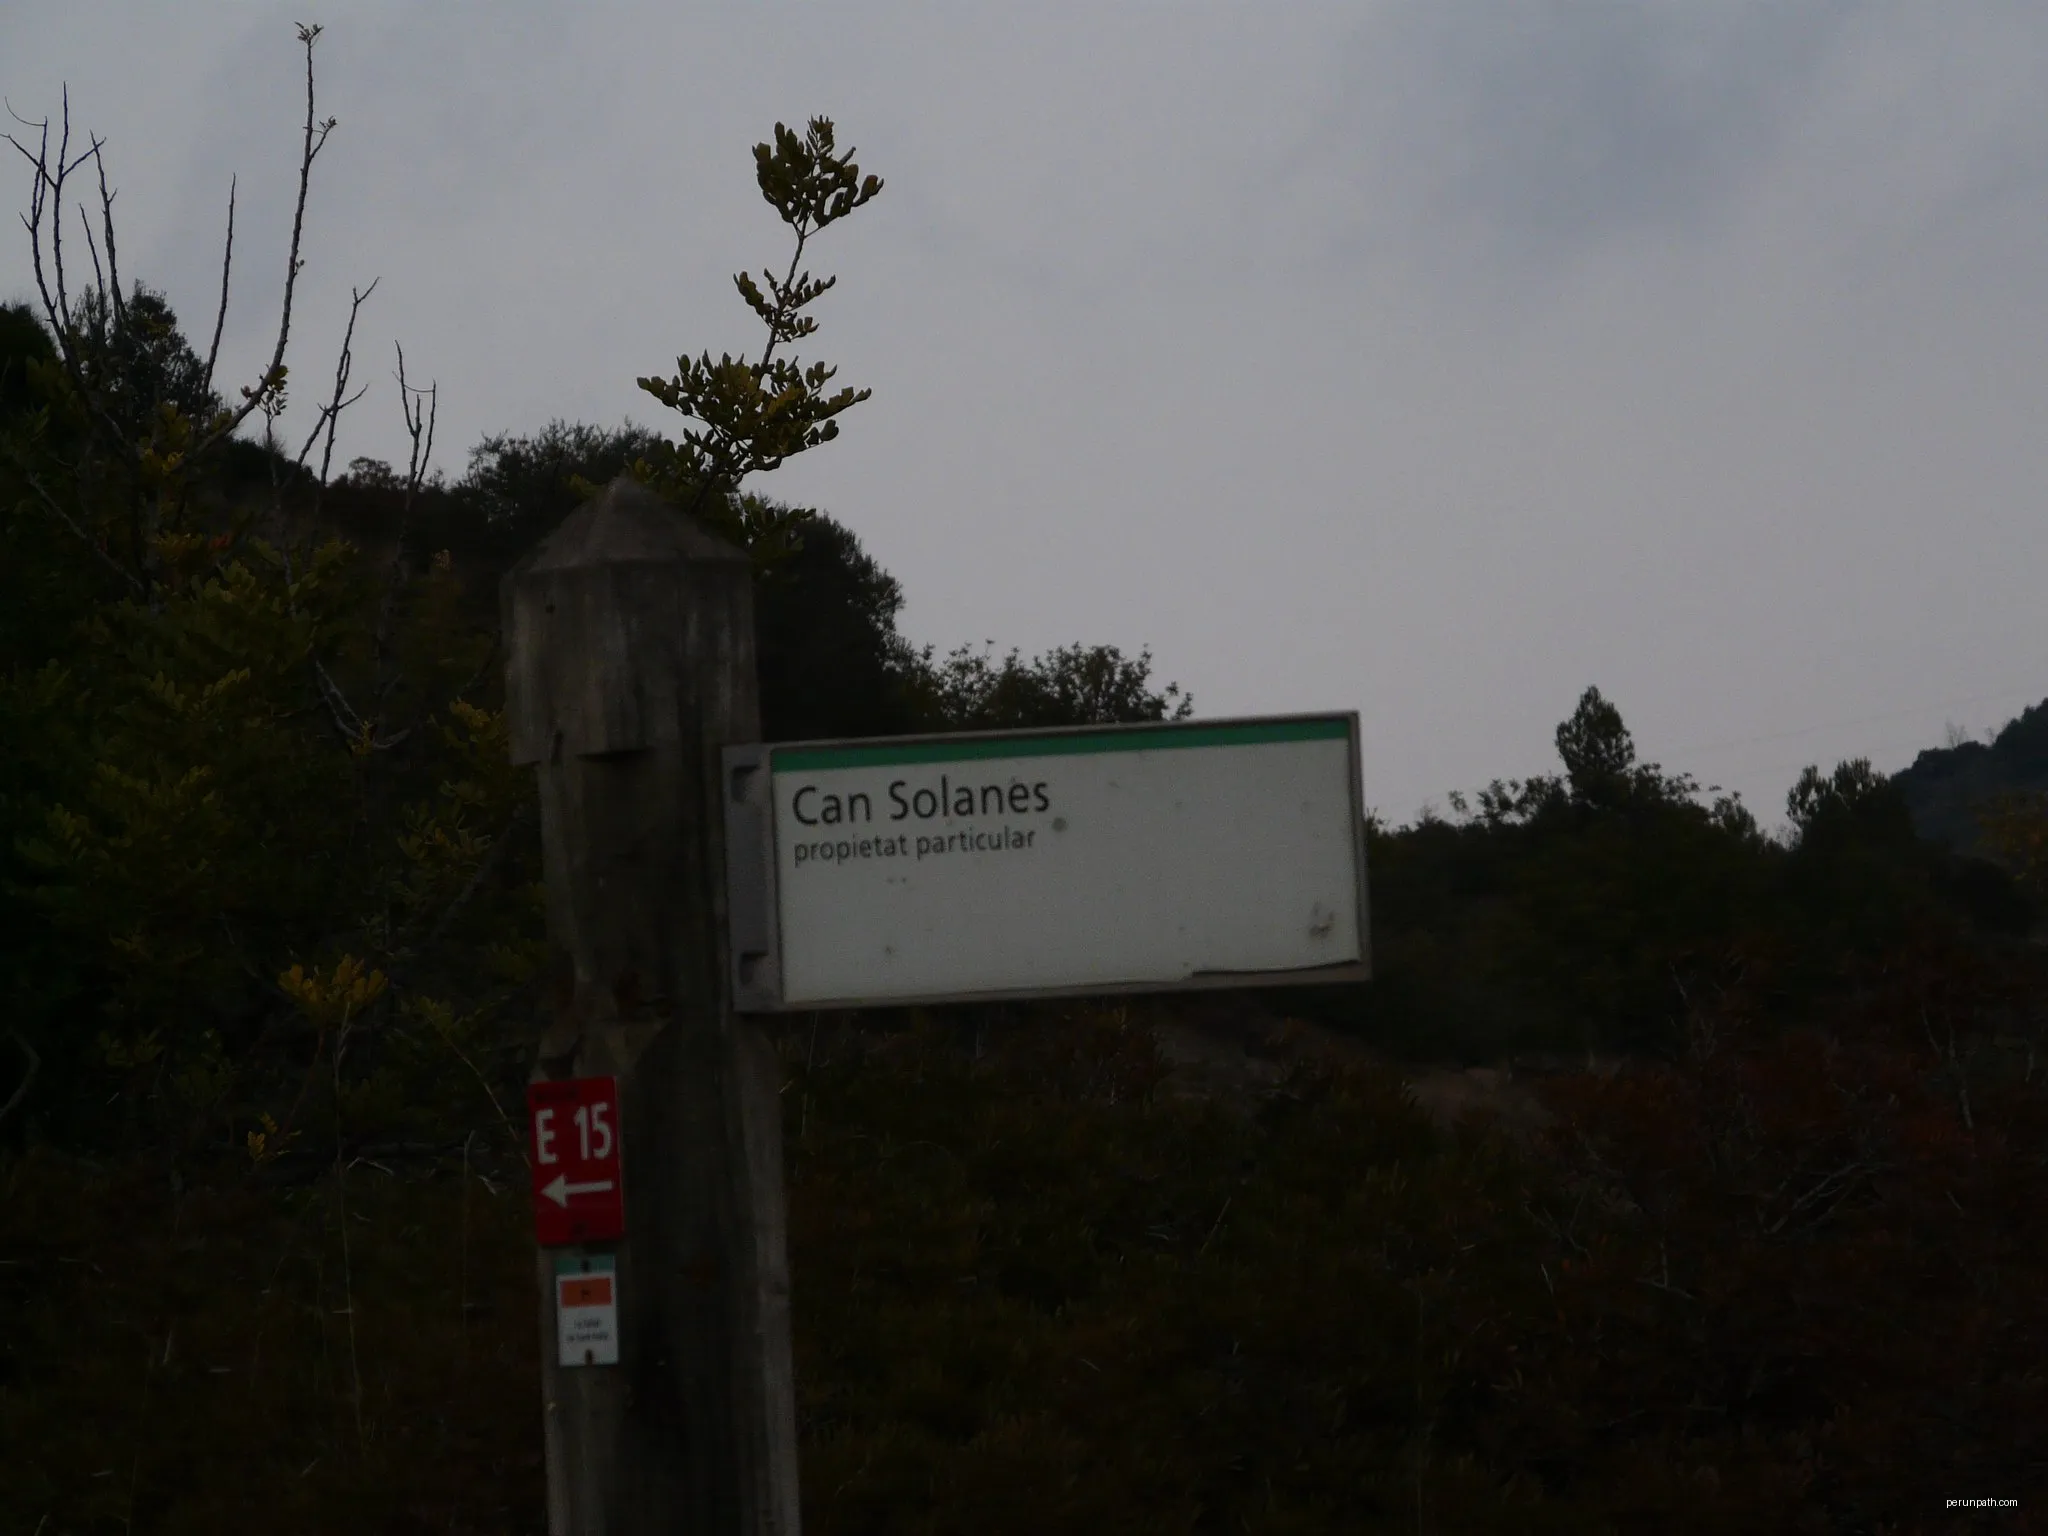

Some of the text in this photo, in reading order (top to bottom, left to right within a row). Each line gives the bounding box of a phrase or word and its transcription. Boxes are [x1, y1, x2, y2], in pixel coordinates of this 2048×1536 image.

[793, 785, 871, 826] Can
[794, 827, 1036, 867] propietat particular
[535, 1101, 613, 1165] E 15
